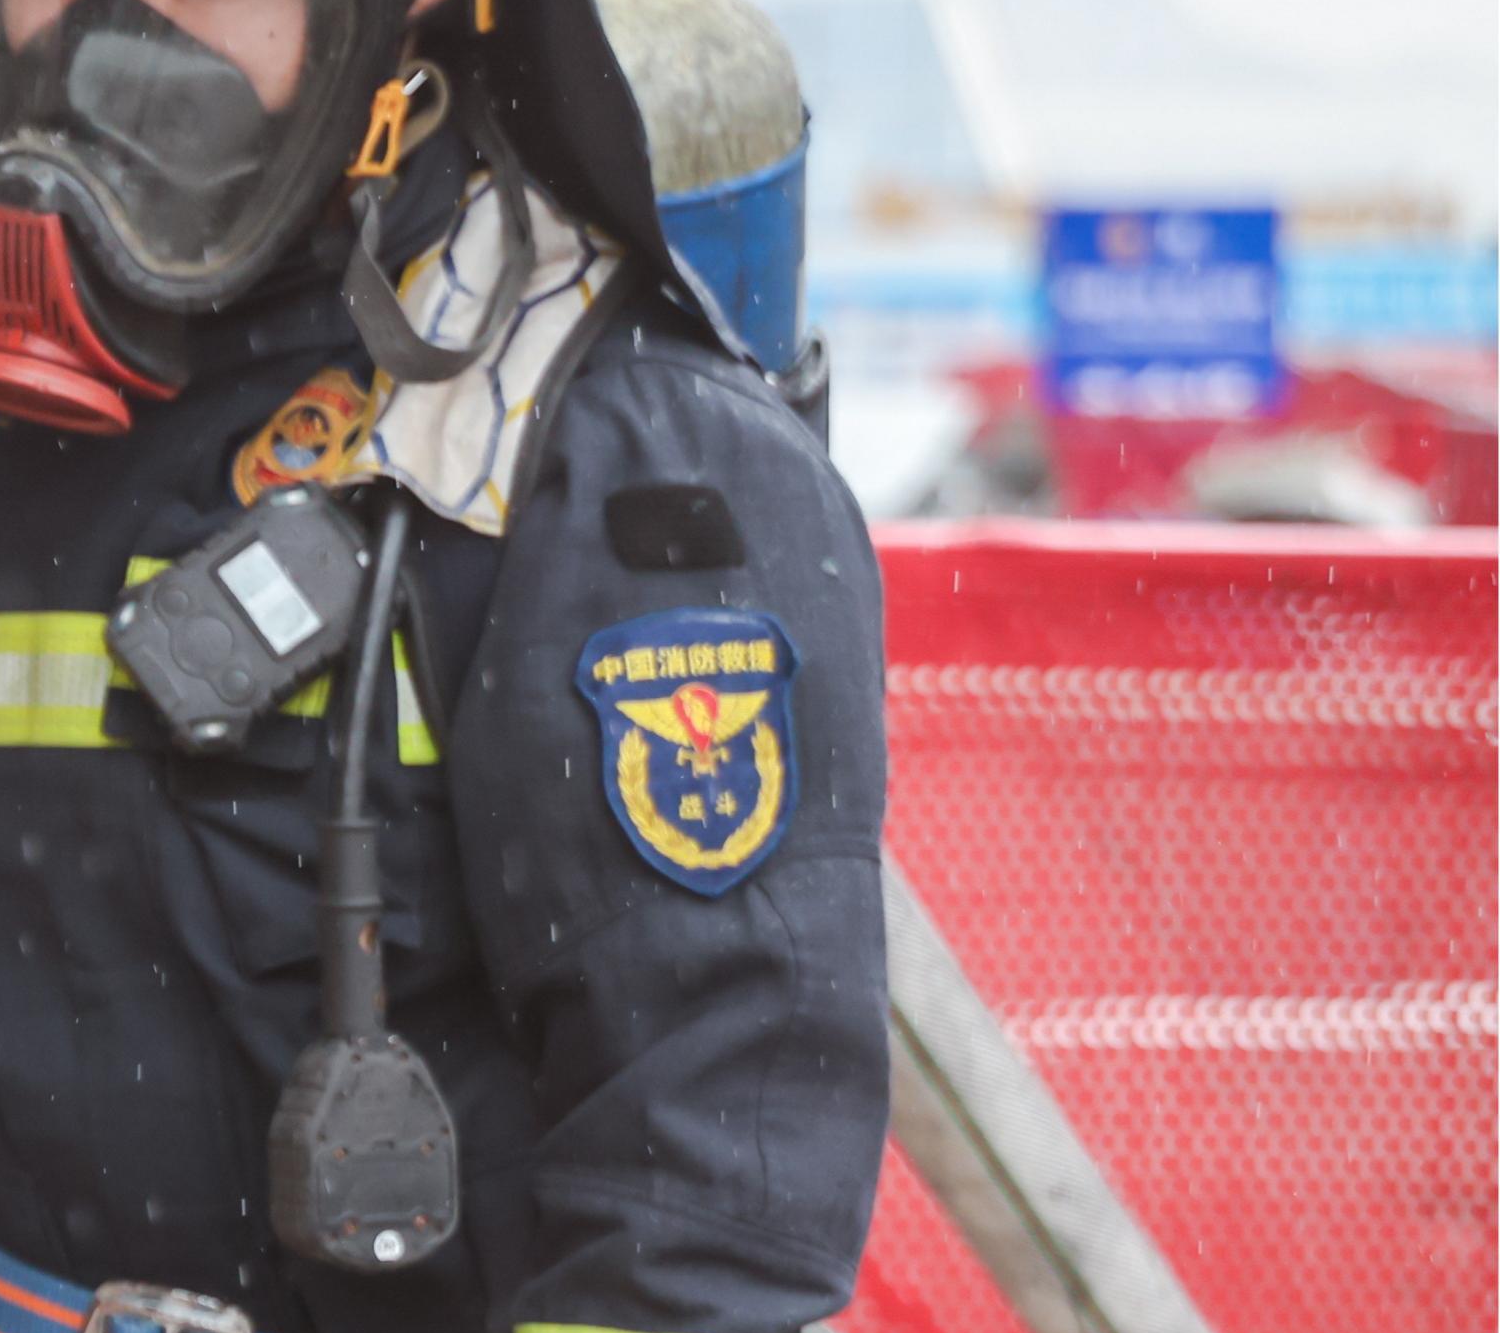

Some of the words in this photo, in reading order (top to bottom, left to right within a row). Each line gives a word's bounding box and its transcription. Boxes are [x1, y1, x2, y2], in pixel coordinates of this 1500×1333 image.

[591, 637, 777, 687] 中国消防救援
